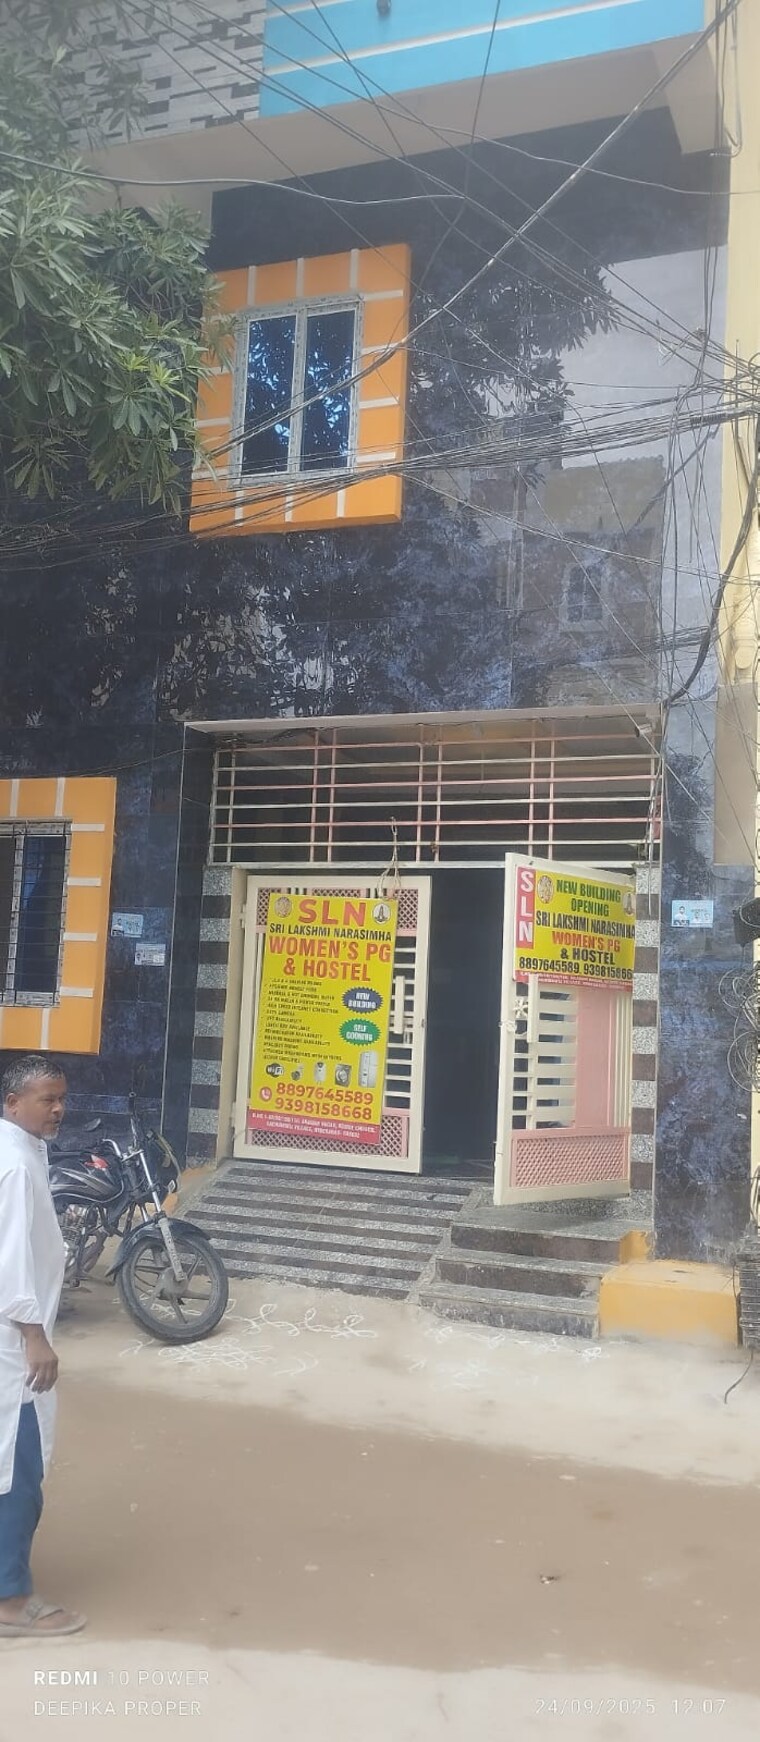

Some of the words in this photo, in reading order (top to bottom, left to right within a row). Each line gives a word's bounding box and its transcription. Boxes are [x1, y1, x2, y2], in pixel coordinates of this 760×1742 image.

[556, 880, 577, 895] NEW
[580, 883, 621, 903] BUILDING
[298, 899, 366, 927] SLN
[519, 870, 534, 943] SLN
[571, 898, 609, 917] OPENING
[269, 922, 285, 934] SRI
[288, 924, 330, 937] LAKSHMI
[333, 927, 392, 942] NARASIMHA
[536, 910, 551, 927] SRI
[553, 912, 589, 933] LAKSHMI
[269, 936, 359, 961] WOMEN'S
[366, 942, 391, 963] PG
[552, 931, 604, 951] WOMEN'S
[608, 939, 621, 953] PG
[560, 948, 569, 959] &
[572, 948, 616, 965] HOSTEL
[283, 957, 295, 976] &
[303, 959, 371, 981] HOSTEL
[347, 999, 377, 1009] BUILDING
[355, 992, 370, 1001] NEW
[276, 1082, 374, 1105] 8897645589
[275, 1097, 372, 1120] 9398158668
